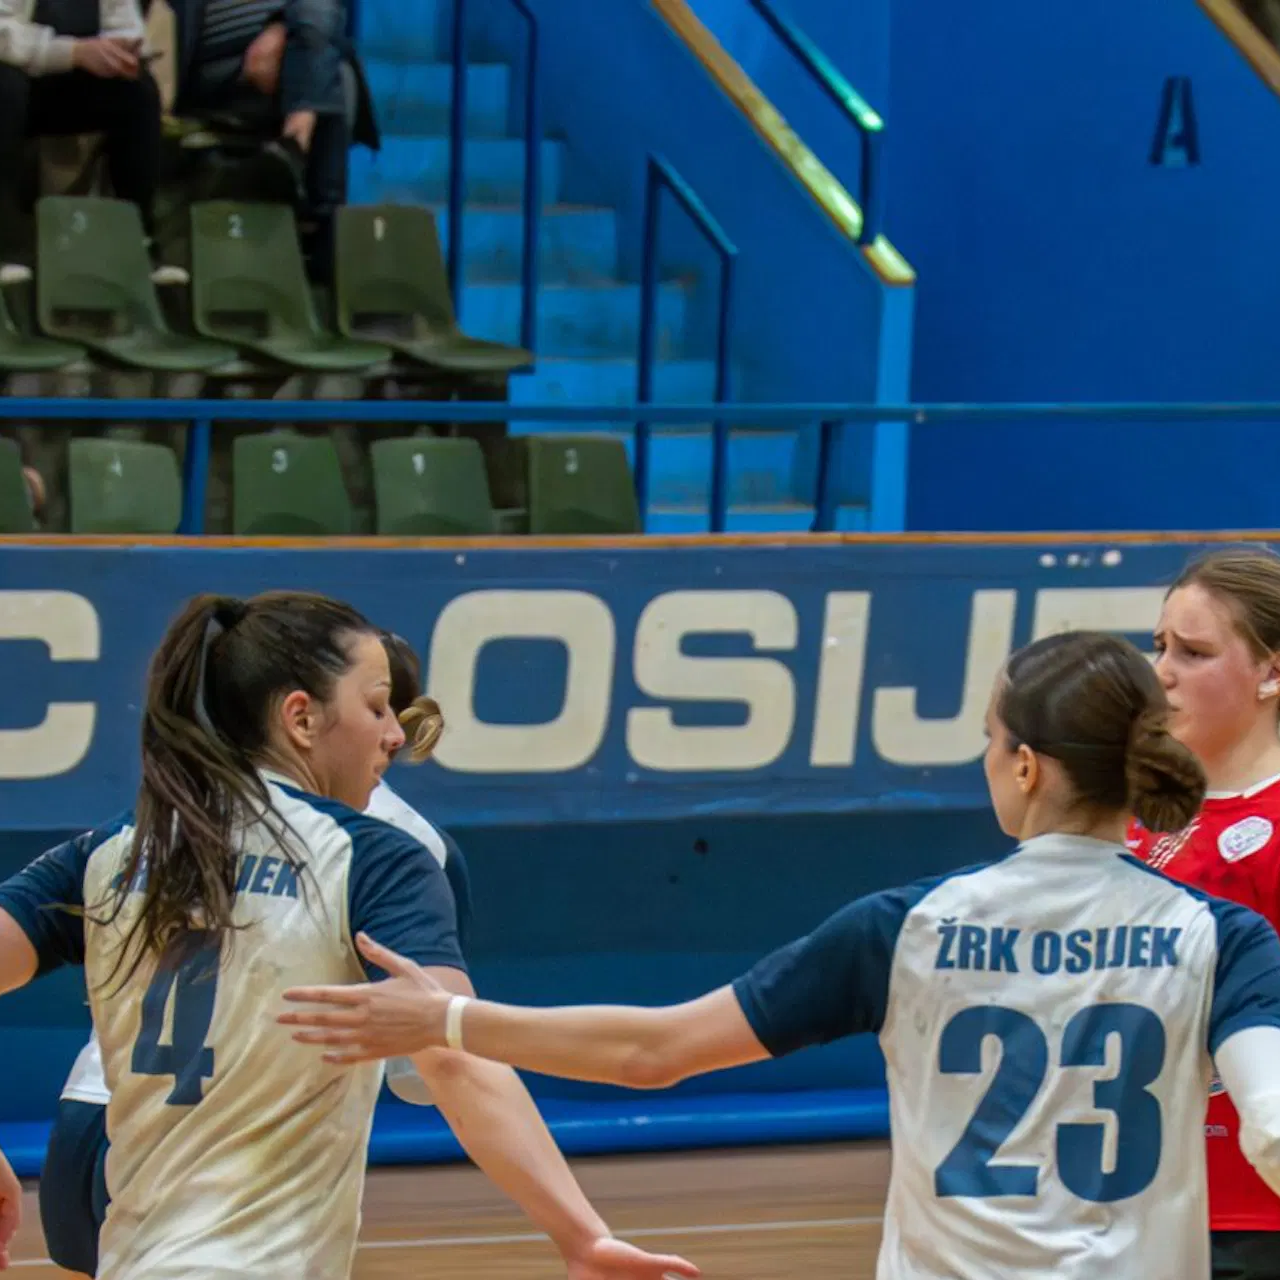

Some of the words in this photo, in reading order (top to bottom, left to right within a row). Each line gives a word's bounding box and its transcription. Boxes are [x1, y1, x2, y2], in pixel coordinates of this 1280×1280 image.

[1148, 76, 1200, 167] A
[934, 916, 1020, 973] ŽRK
[1031, 925, 1183, 975] OSIJEK
[131, 928, 220, 1105] 4
[934, 1002, 1166, 1204] 23
